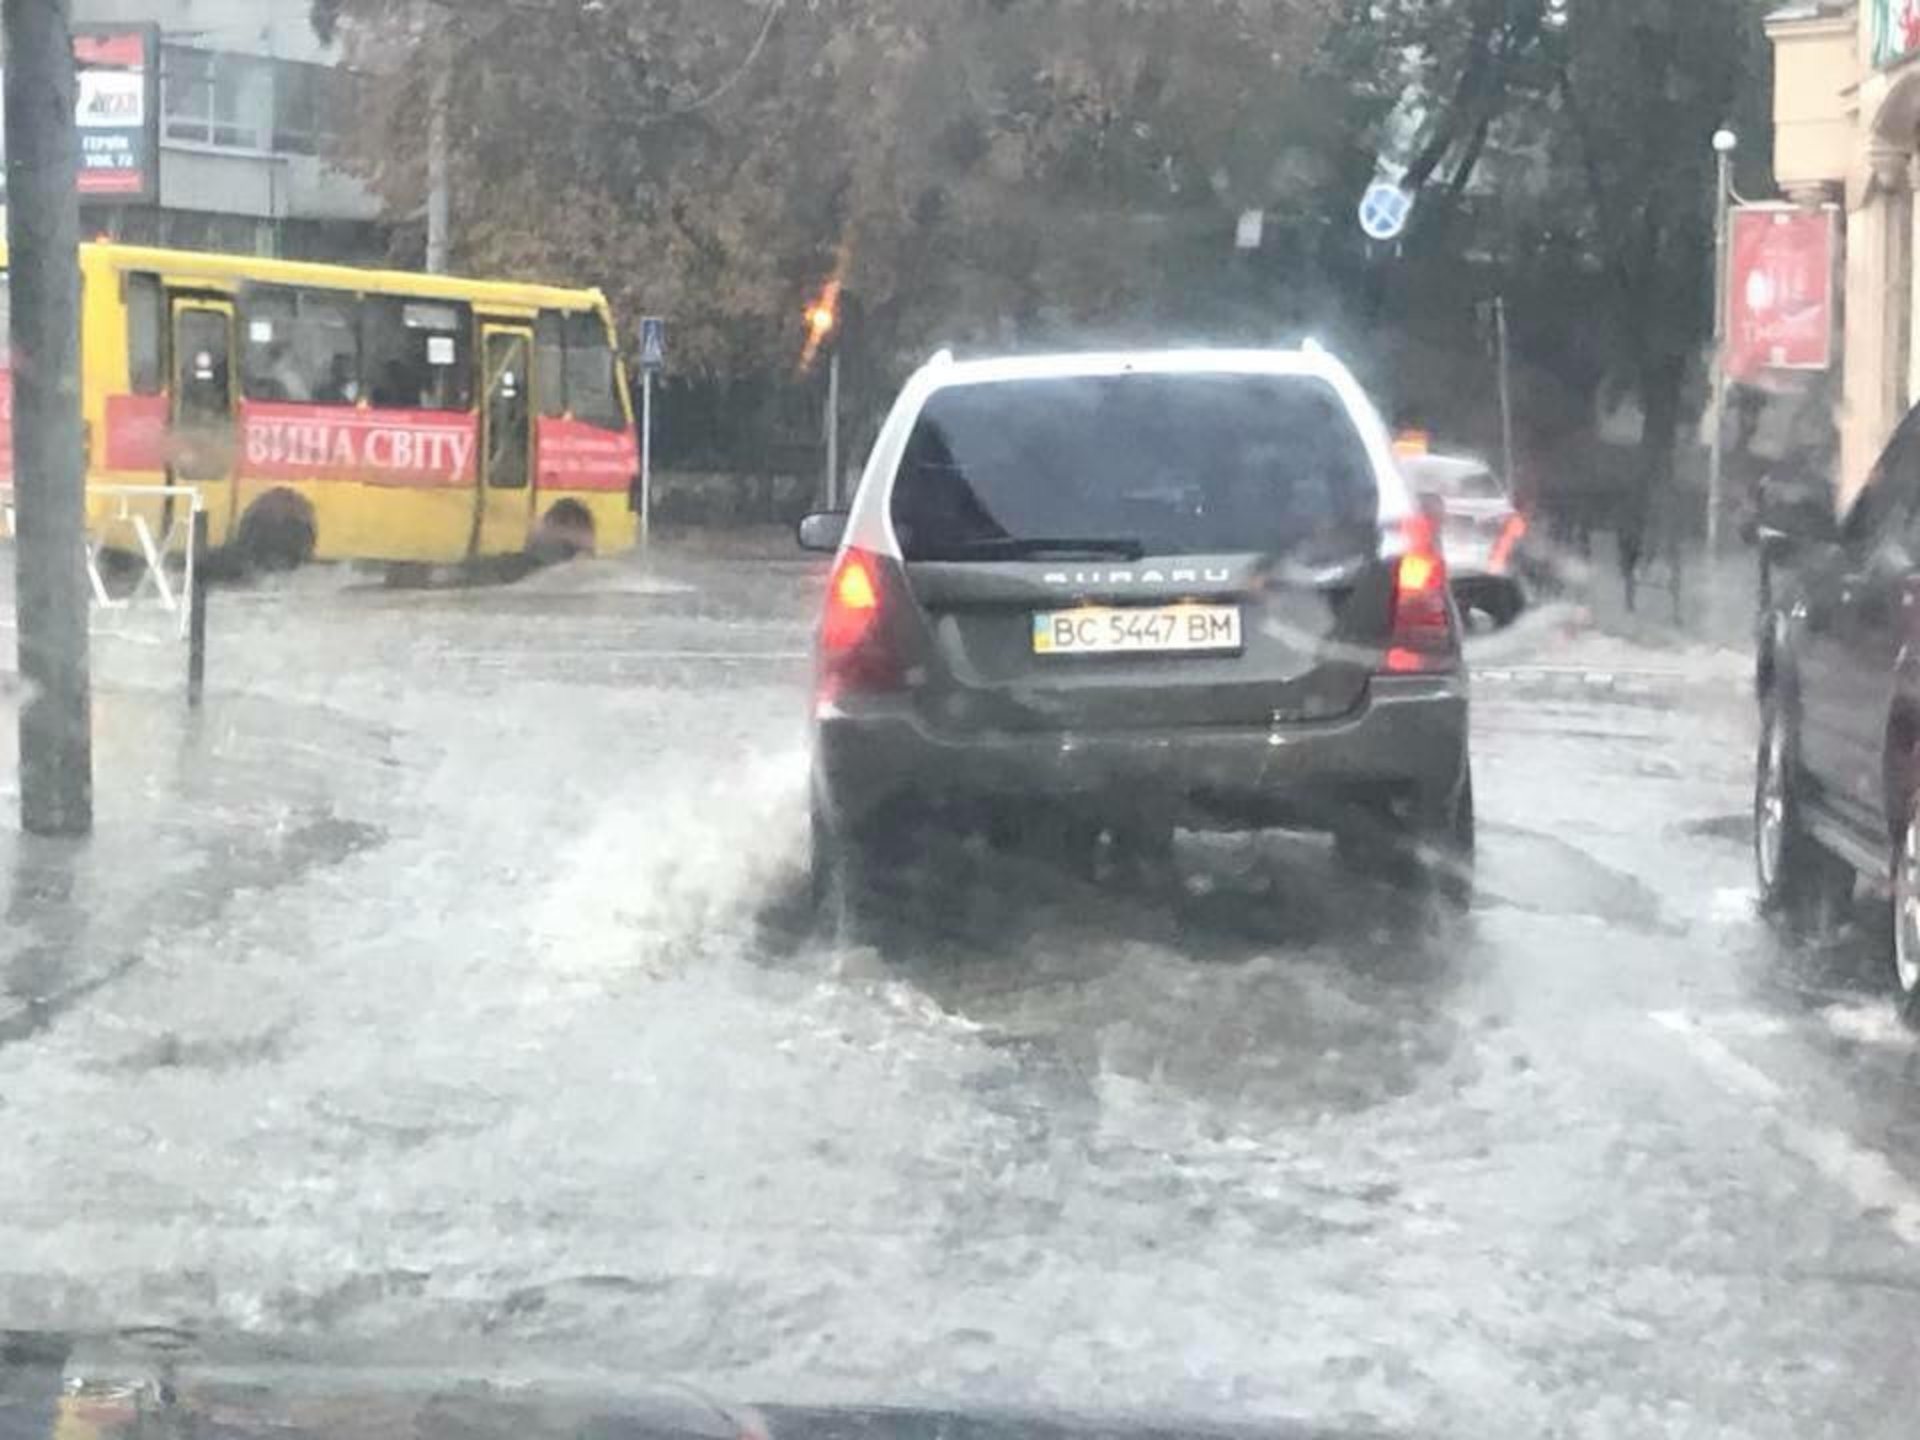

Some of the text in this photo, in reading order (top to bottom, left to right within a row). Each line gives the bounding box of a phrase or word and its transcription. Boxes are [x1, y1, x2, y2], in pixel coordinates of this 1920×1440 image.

[364, 430, 474, 480] СВІТУ
[1044, 568, 1229, 583] SUBARU
[1054, 613, 1232, 646] BC 5447 BM
